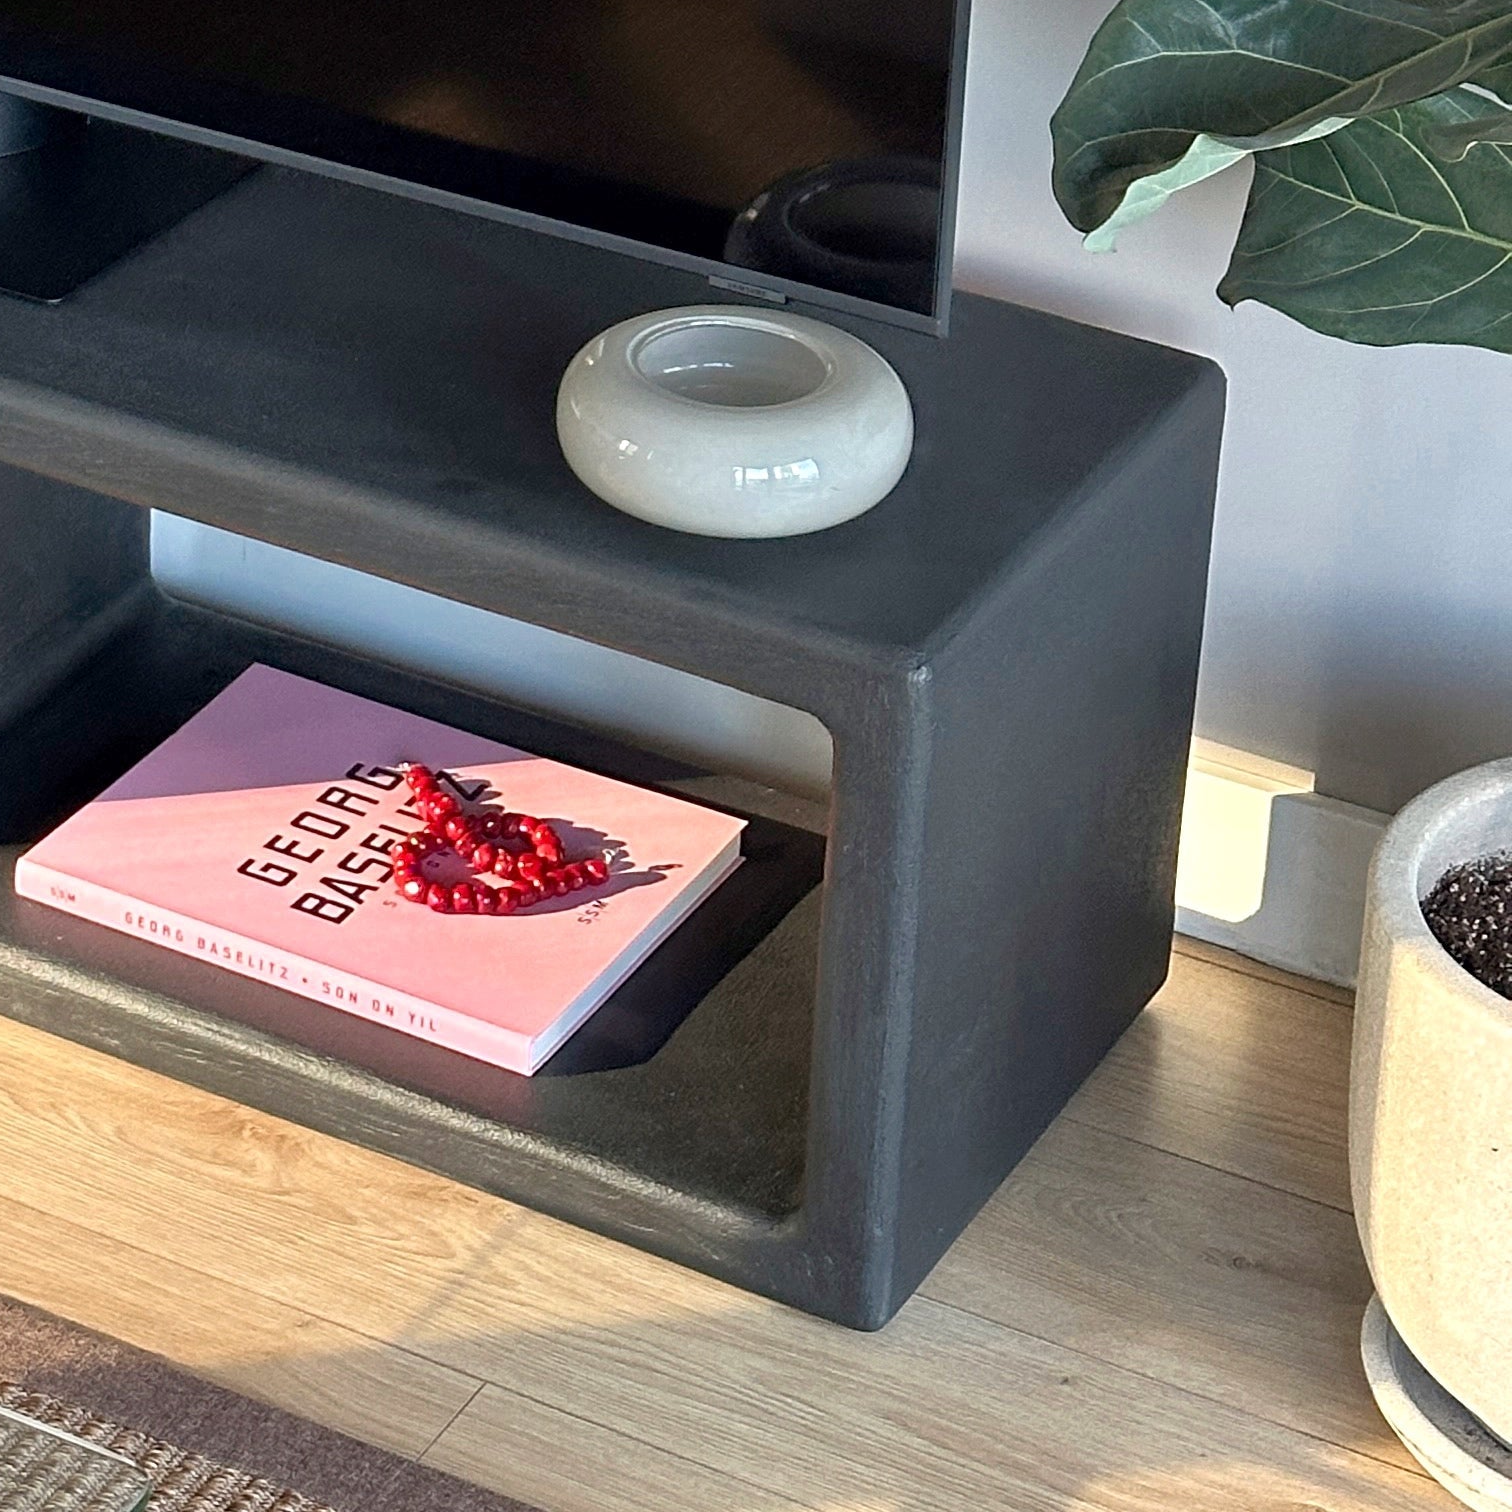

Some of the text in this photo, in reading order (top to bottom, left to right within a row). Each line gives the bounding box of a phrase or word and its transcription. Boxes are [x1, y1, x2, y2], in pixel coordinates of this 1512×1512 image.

[237, 763, 404, 887] GEORG
[125, 912, 437, 1032] GEORG BASELITZ SON ON YIL
